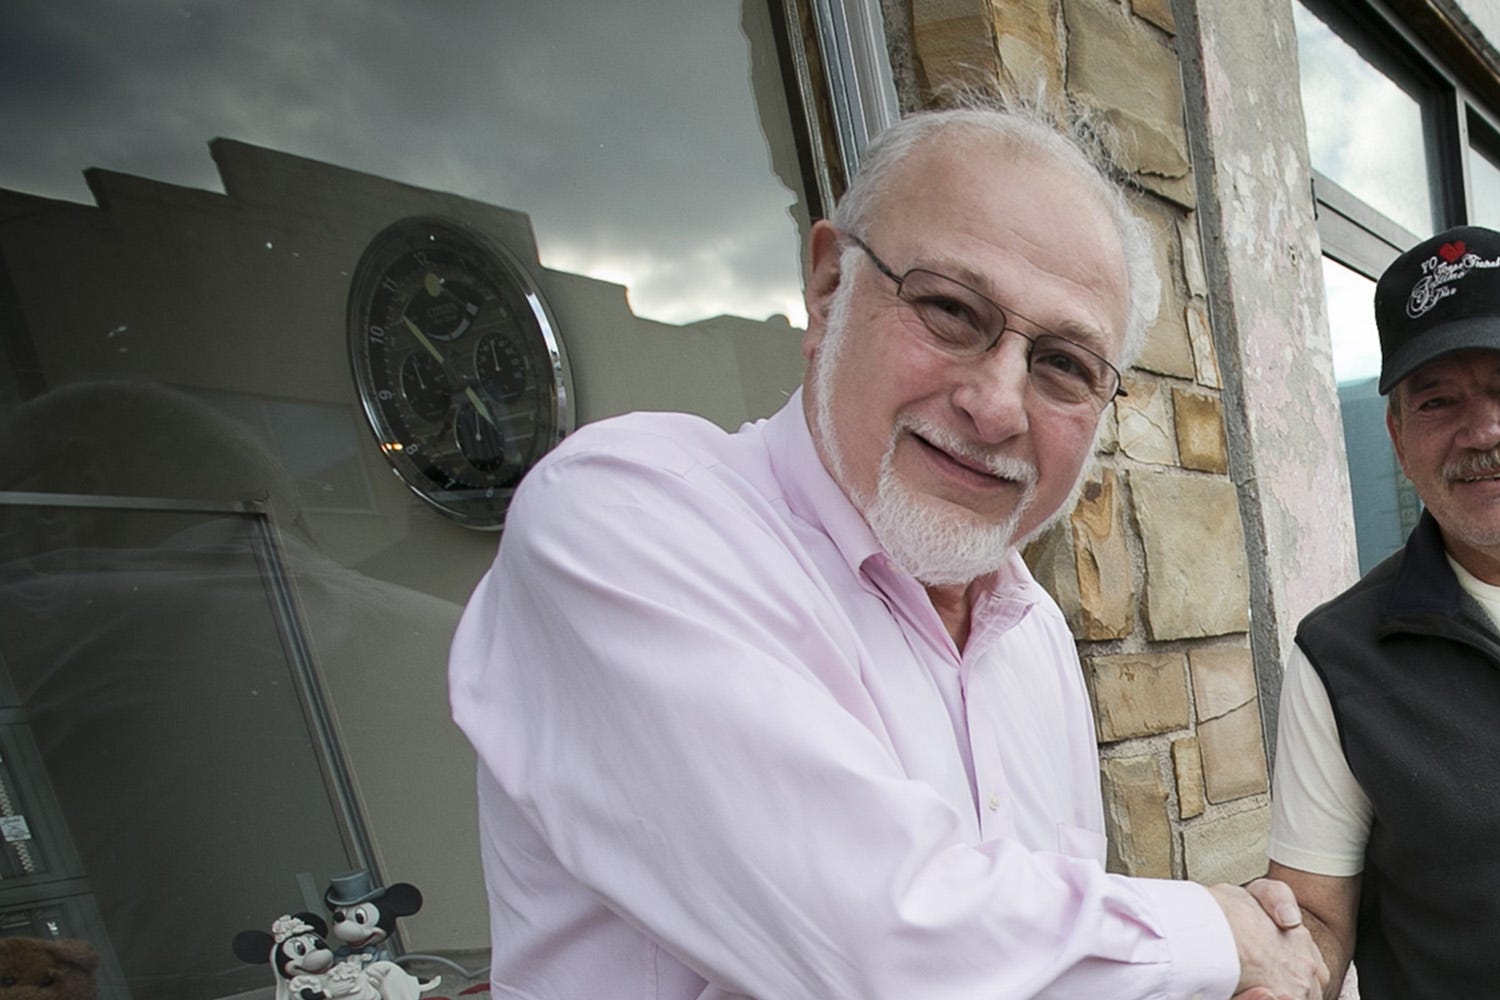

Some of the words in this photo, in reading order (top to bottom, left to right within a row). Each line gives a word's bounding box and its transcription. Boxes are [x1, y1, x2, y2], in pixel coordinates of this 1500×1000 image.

[1421, 256, 1438, 274] YO
[370, 325, 385, 344] 10
[405, 443, 418, 455] 8
